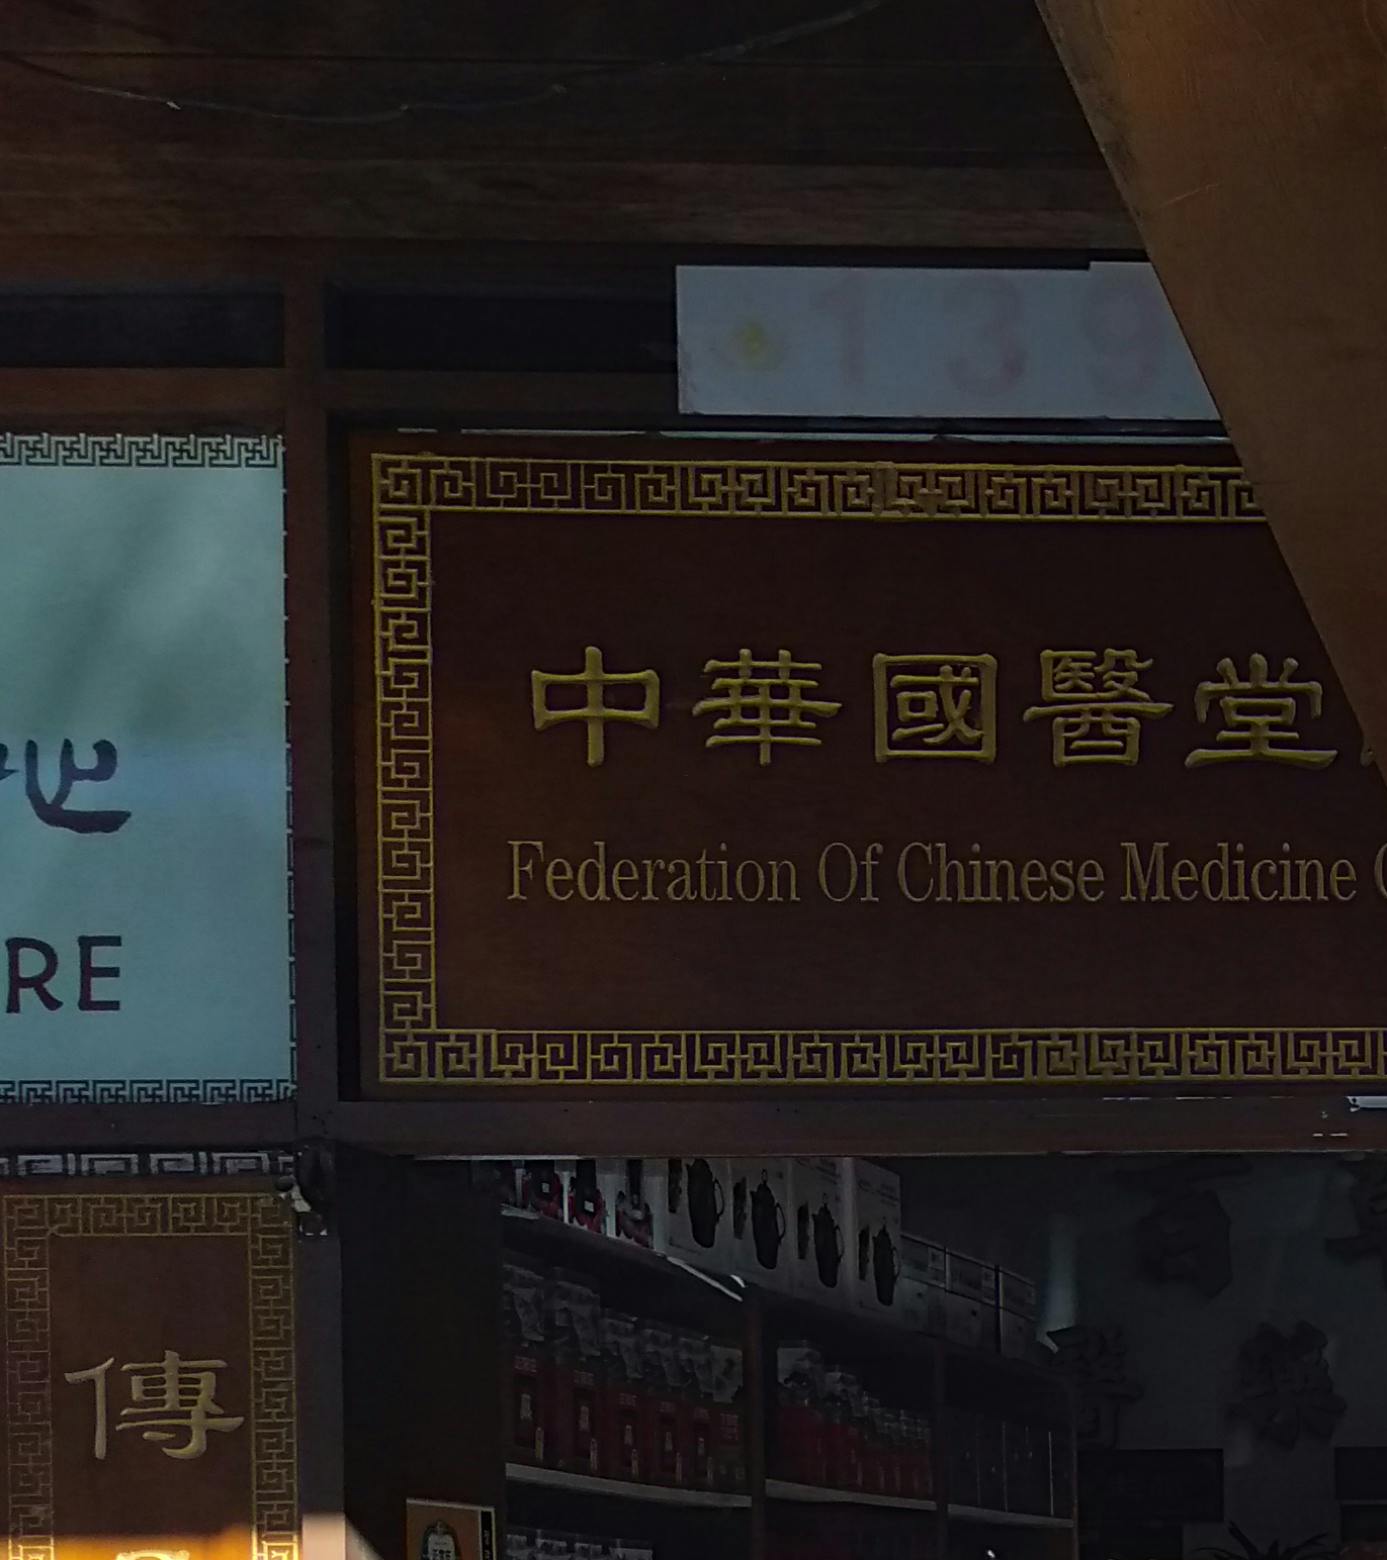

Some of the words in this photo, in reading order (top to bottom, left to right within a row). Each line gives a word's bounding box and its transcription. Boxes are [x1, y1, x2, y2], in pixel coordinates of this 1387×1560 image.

[530, 645, 1378, 768] 中華國醫堂
[508, 840, 800, 902] Federation
[819, 842, 882, 902] Of
[897, 841, 1104, 904] Chinese
[1120, 841, 1357, 904] Medicine
